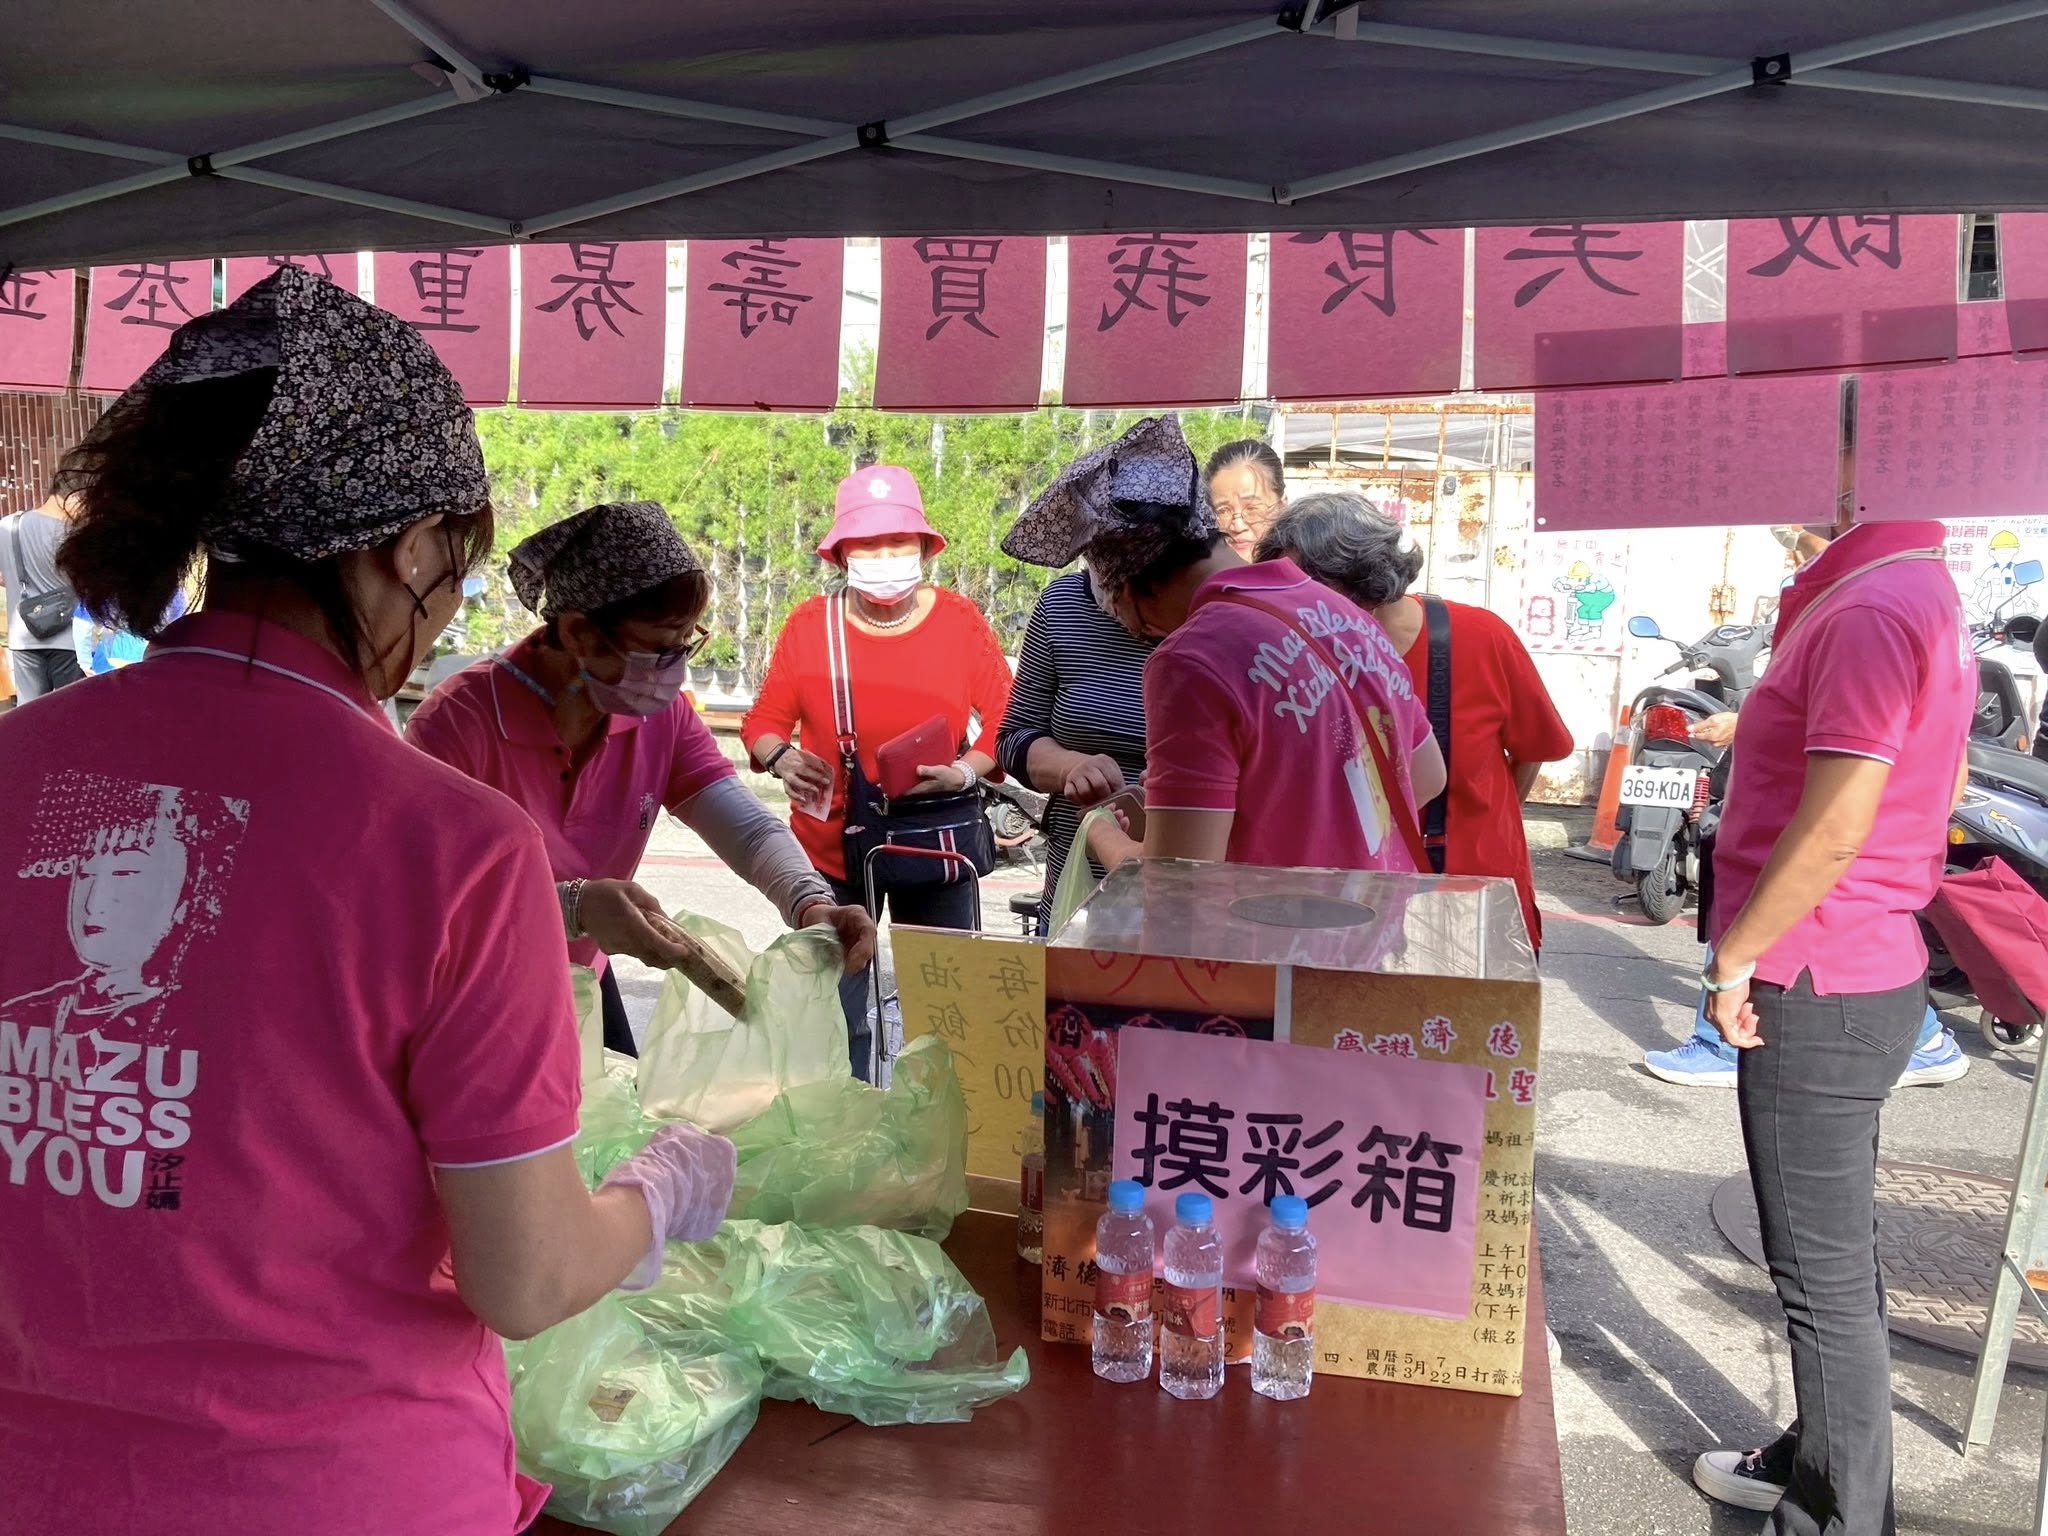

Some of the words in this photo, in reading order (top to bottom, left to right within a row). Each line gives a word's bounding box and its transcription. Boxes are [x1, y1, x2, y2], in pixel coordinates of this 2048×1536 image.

[0, 1020, 199, 1100] MAZU
[0, 1076, 192, 1149] BLESS
[0, 1124, 146, 1209] YOU
[1131, 1092, 1464, 1233] 摸彩箱
